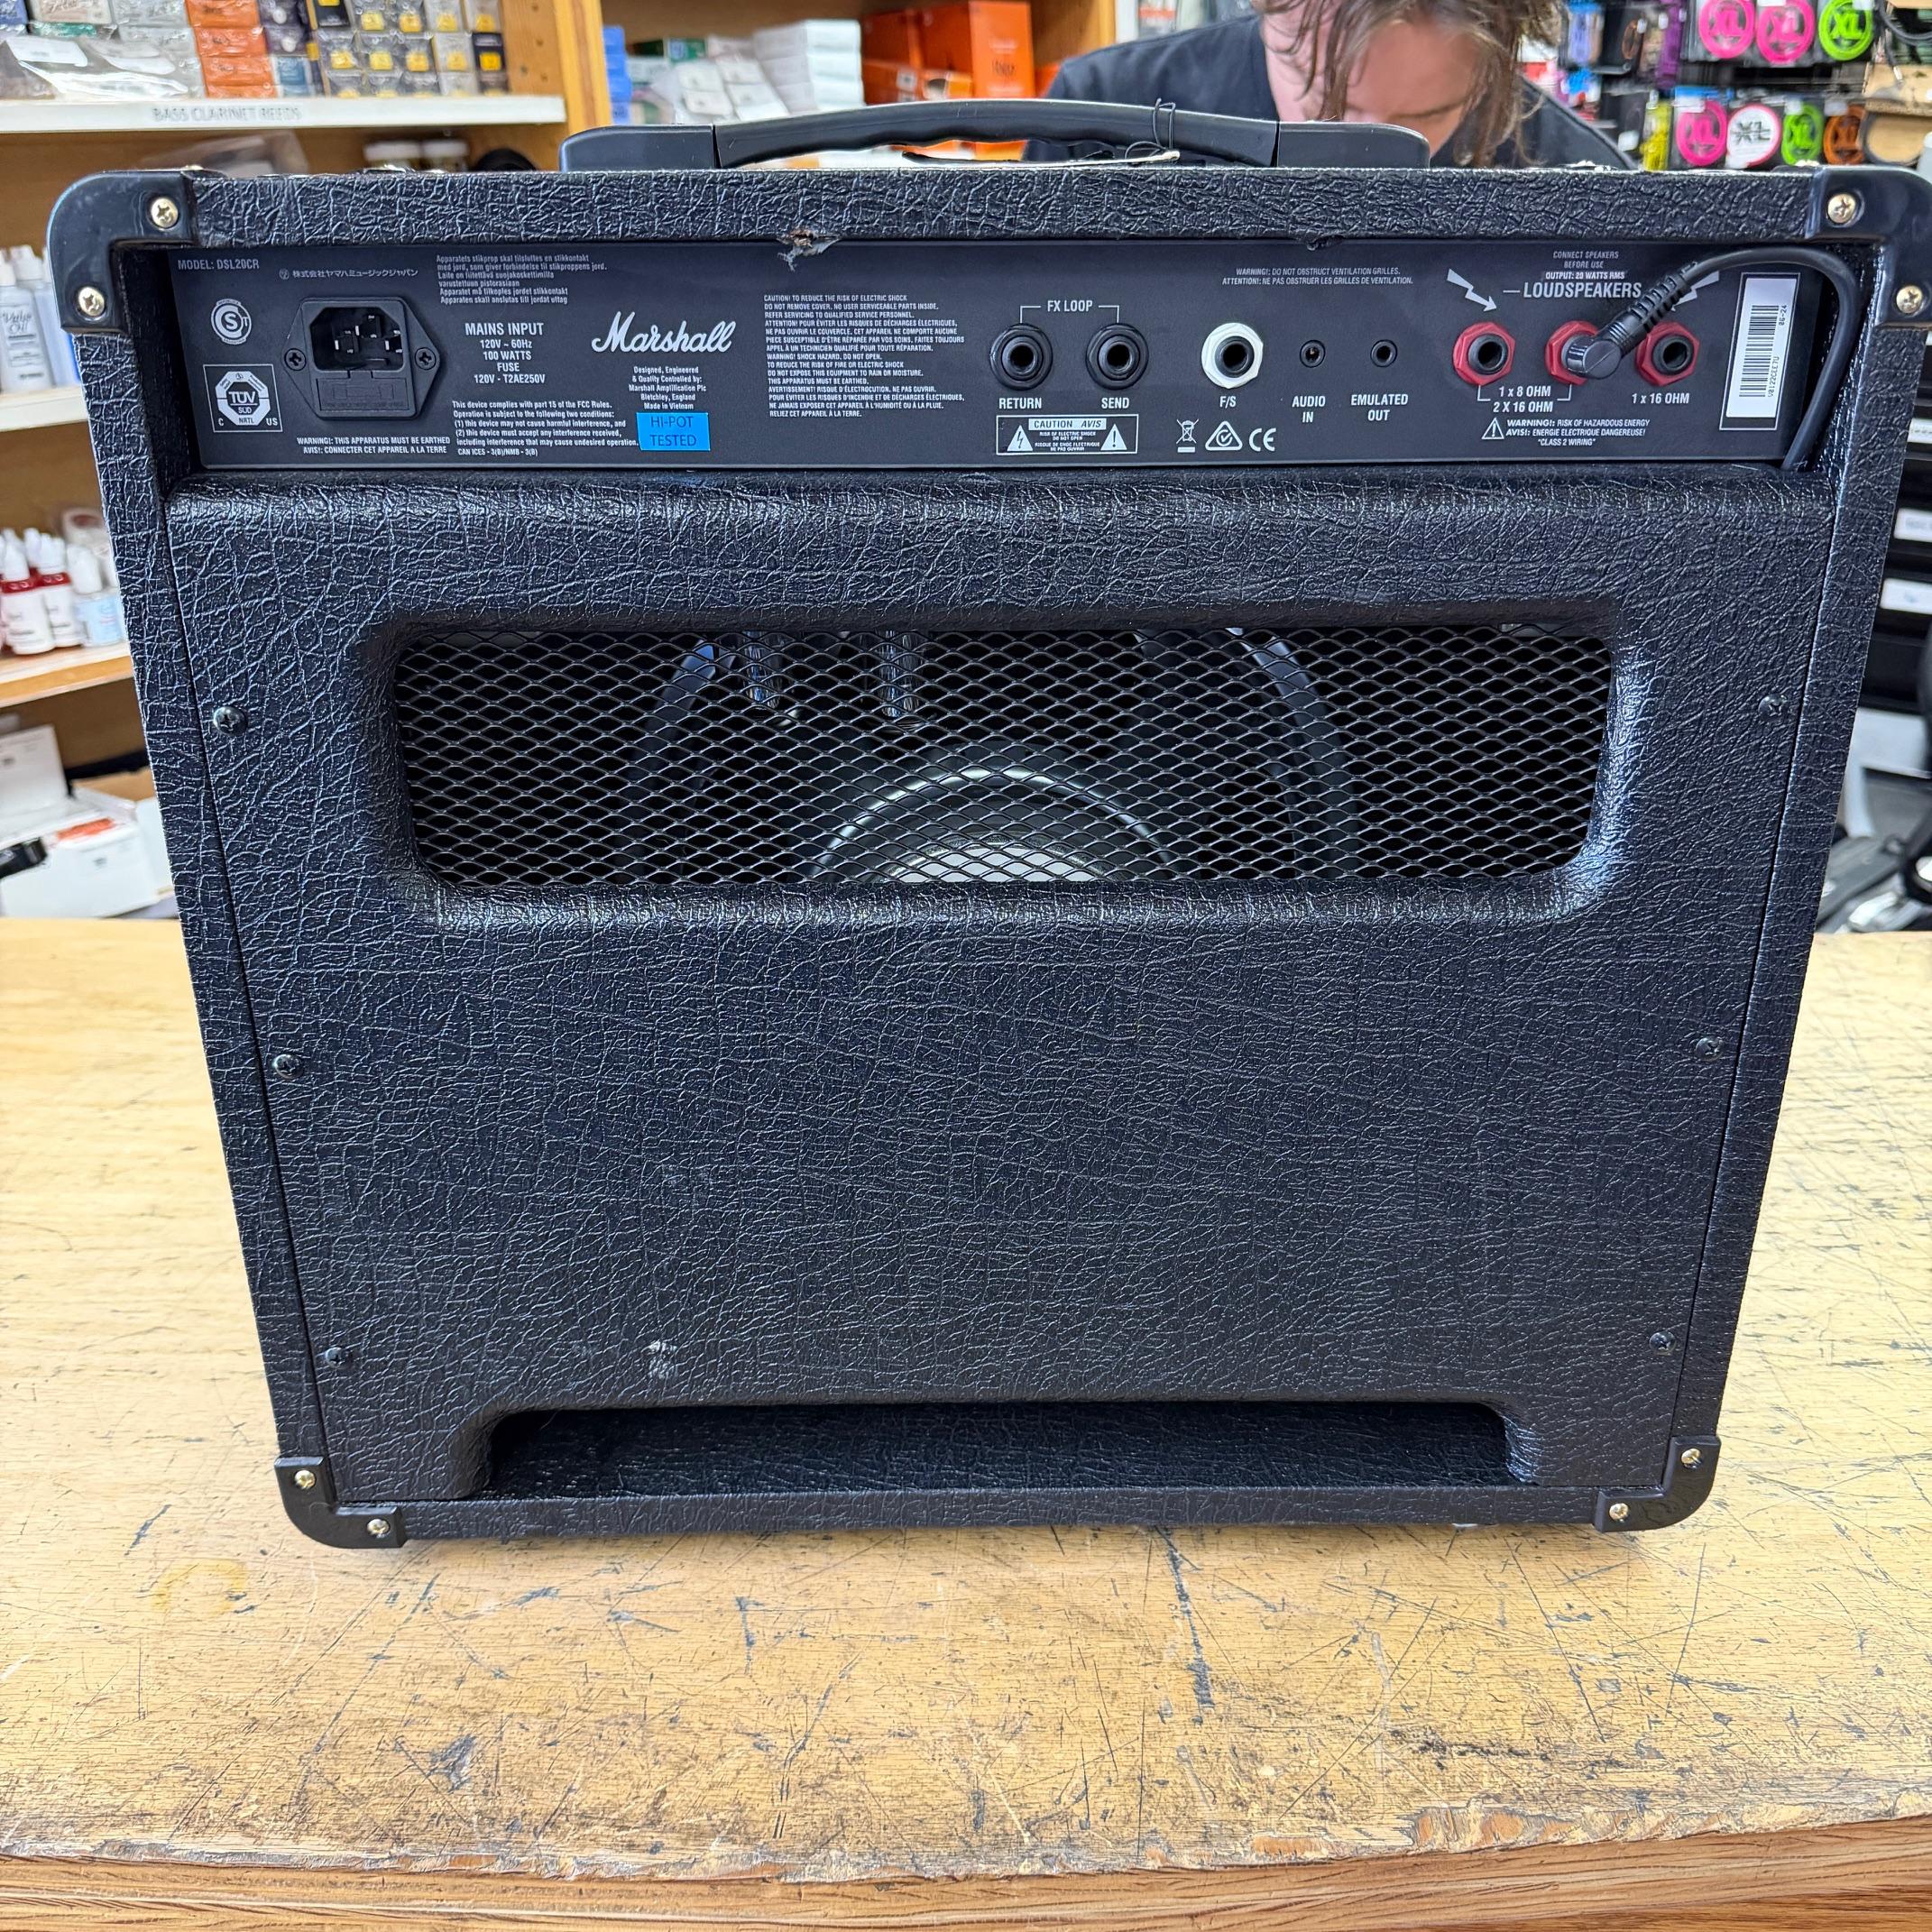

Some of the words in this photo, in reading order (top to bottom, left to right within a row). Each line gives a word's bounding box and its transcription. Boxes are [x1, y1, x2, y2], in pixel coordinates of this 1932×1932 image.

[1831, 12, 1863, 40] XL
[152, 107, 189, 122] BASS
[191, 106, 256, 122] CLARINET
[260, 106, 303, 121] REEDS
[1730, 121, 1771, 145] XL
[1553, 251, 1583, 260] CONNECT
[1585, 251, 1619, 260] SPEAKERS
[178, 259, 214, 270] MODEL:
[216, 259, 259, 270] DSL20CR
[1564, 261, 1589, 269] BEFORE
[1590, 261, 1604, 269] USE
[1272, 268, 1282, 276] DO
[1283, 268, 1295, 276] NOT
[1296, 268, 1329, 276] OBSTRUCT
[1331, 268, 1372, 276] VENTILATION
[1372, 268, 1400, 276] GRILLES.
[1545, 271, 1574, 280] OUTPUT:
[1575, 271, 1584, 280] 20
[1585, 271, 1608, 280] WATTS
[1609, 271, 1625, 280] RMS
[1262, 276, 1270, 285] NE
[1272, 276, 1284, 285] PAS
[1285, 276, 1320, 285] OBSTRUER
[1320, 276, 1332, 285] LES
[1333, 276, 1360, 285] GRILLES
[1361, 276, 1369, 285] DE
[1370, 276, 1413, 285] VENTILATION.
[1523, 282, 1642, 299] LOUDSPEAKERS
[1047, 300, 1061, 312] FX
[1063, 300, 1093, 312] LOOP
[465, 322, 504, 336] MAINS
[508, 322, 544, 336] INPUT
[591, 310, 737, 353] Marshall
[480, 339, 501, 349] 120V
[511, 339, 533, 349] 60Hz
[483, 351, 499, 361] 100
[501, 351, 532, 361] WATTS
[497, 362, 520, 372] FUSE
[633, 366, 664, 375] Designed,
[665, 366, 699, 375] Engineered
[474, 374, 494, 384] 120V
[503, 374, 546, 384] T2AE250V
[638, 375, 659, 384] Quality
[660, 375, 692, 384] Controlled
[693, 375, 703, 384] by:
[629, 384, 655, 393] Marshall
[656, 384, 695, 393] Amplification
[696, 384, 706, 393] Plc
[1498, 385, 1504, 398] 1
[1508, 385, 1513, 398] x
[1516, 385, 1523, 398] 8
[1526, 385, 1551, 398] OHM
[228, 391, 256, 403] TÜV
[640, 393, 670, 402] Bletchley,
[671, 393, 695, 402] England
[1219, 395, 1237, 408] F/S
[1292, 395, 1326, 407] AUDIO
[1351, 393, 1409, 406] EMULATED
[1632, 392, 1637, 404] 1
[1641, 392, 1646, 404] x
[1651, 392, 1661, 404] 16
[1664, 392, 1689, 404] OHM
[452, 400, 465, 409] This
[467, 400, 488, 409] device
[489, 400, 518, 409] complies
[519, 400, 533, 409] with
[534, 400, 547, 409] part
[548, 400, 557, 409] 15
[557, 400, 565, 409] of
[566, 400, 575, 409] the
[577, 400, 590, 409] FCC
[591, 400, 612, 409] Rules.
[644, 402, 661, 410] Made
[661, 402, 668, 410] in
[669, 402, 694, 410] Vietnam
[998, 398, 1042, 409] RETURN
[1101, 398, 1129, 409] SEND
[1493, 400, 1500, 413] 2
[1503, 400, 1510, 413] X
[1513, 400, 1525, 413] 16
[1528, 400, 1553, 413] OHM
[453, 409, 484, 419] Operation
[485, 409, 492, 419] is
[492, 409, 516, 419] subject
[517, 409, 523, 419] to
[524, 409, 535, 419] the
[536, 409, 566, 419] following
[566, 409, 578, 419] two
[579, 409, 614, 419] conditions:
[1302, 411, 1313, 423] IN
[1366, 409, 1390, 421] OUT
[650, 416, 694, 428] HI-POT
[1034, 419, 1072, 428] CAUTION
[1081, 419, 1102, 428] AVIS
[1557, 419, 1572, 428] RISK
[1574, 419, 1582, 428] OF
[1583, 419, 1623, 428] HAZARDOUS
[1624, 419, 1650, 428] ENERGY
[1505, 428, 1531, 437] AVIS!:
[1532, 428, 1559, 437] ENERGIE
[1560, 428, 1600, 437] ELECTRIQUE
[1600, 428, 1646, 437] DANGEREUSE!
[335, 436, 350, 446] THIS
[351, 436, 390, 446] APPARATUS
[391, 436, 409, 446] MUST
[410, 436, 419, 446] BE
[420, 436, 450, 446] EARTHED
[649, 435, 696, 446] TESTED
[324, 446, 363, 455] CONNECTER
[363, 446, 375, 455] CET
[377, 446, 409, 455] APPAREIL
[410, 446, 415, 455] A
[416, 446, 425, 455] LA
[426, 446, 447, 455] TERRE
